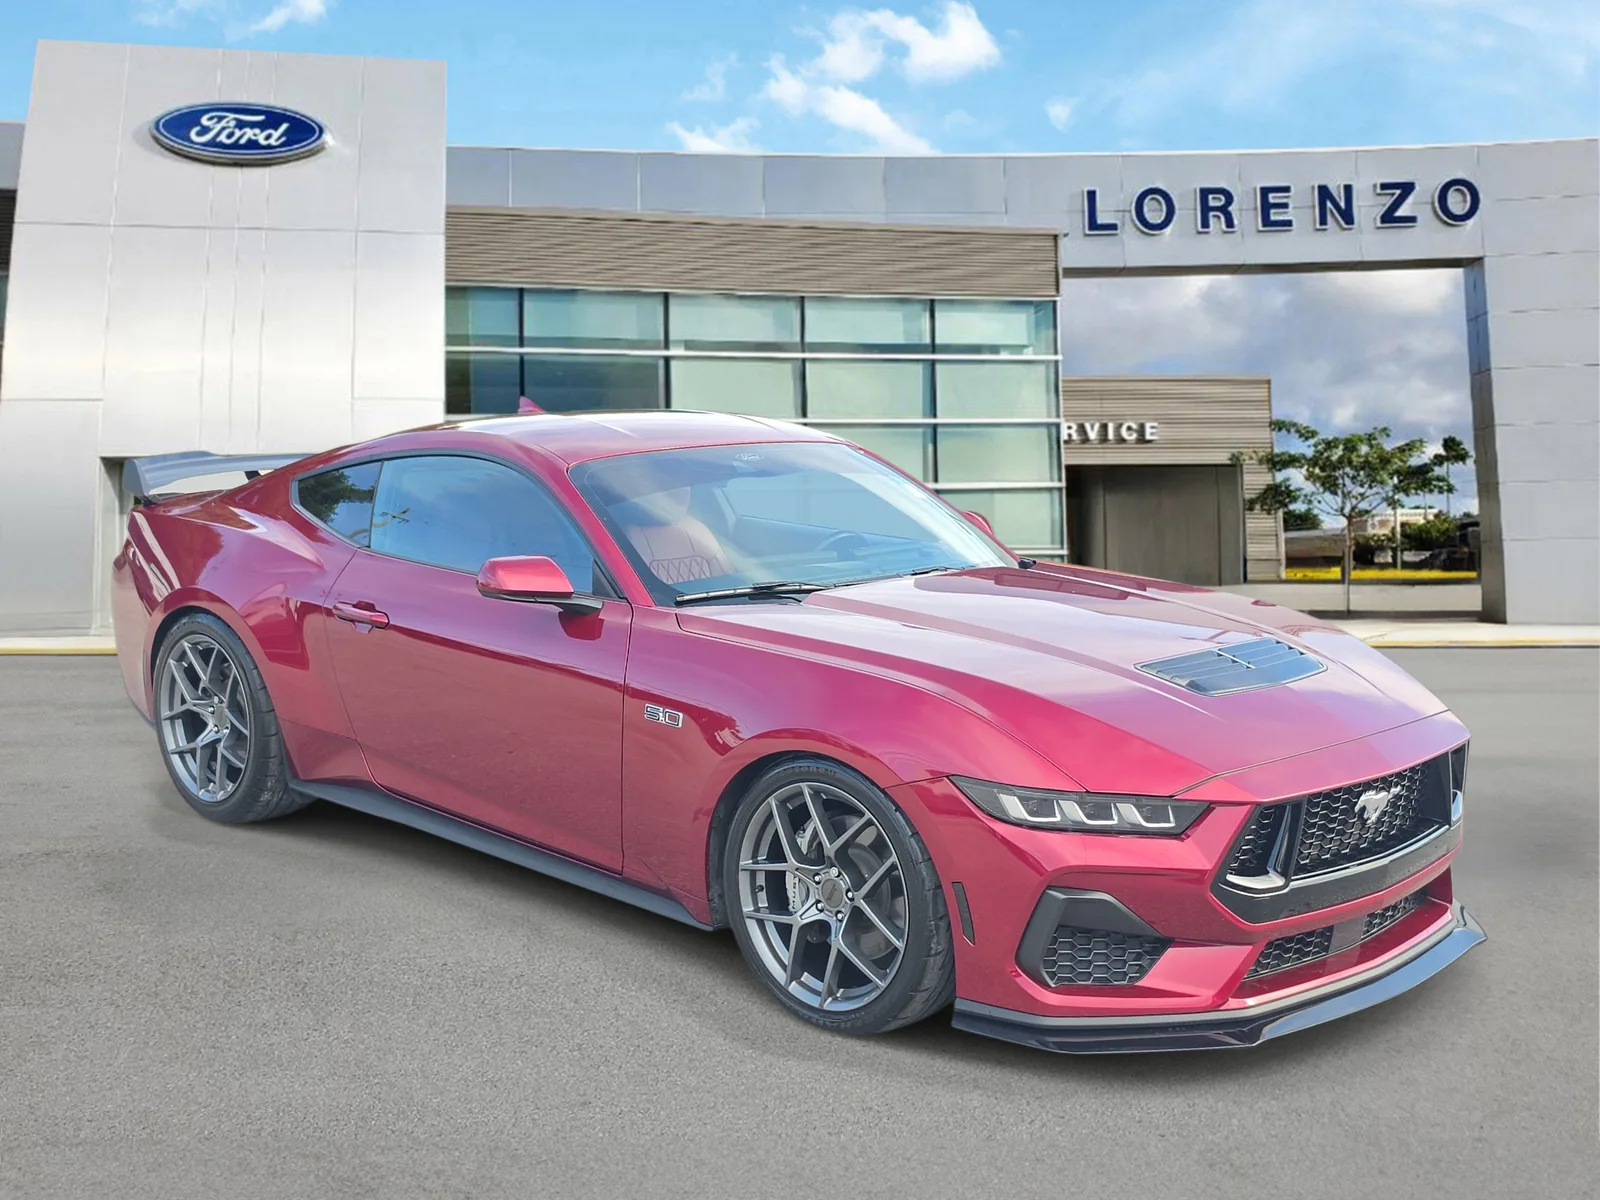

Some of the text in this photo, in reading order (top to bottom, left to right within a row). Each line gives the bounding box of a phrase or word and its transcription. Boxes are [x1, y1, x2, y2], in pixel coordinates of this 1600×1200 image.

[190, 111, 290, 146] Ford
[1084, 178, 1481, 234] LORENZO
[1063, 422, 1159, 440] RVICE
[644, 703, 683, 728] 5.0
